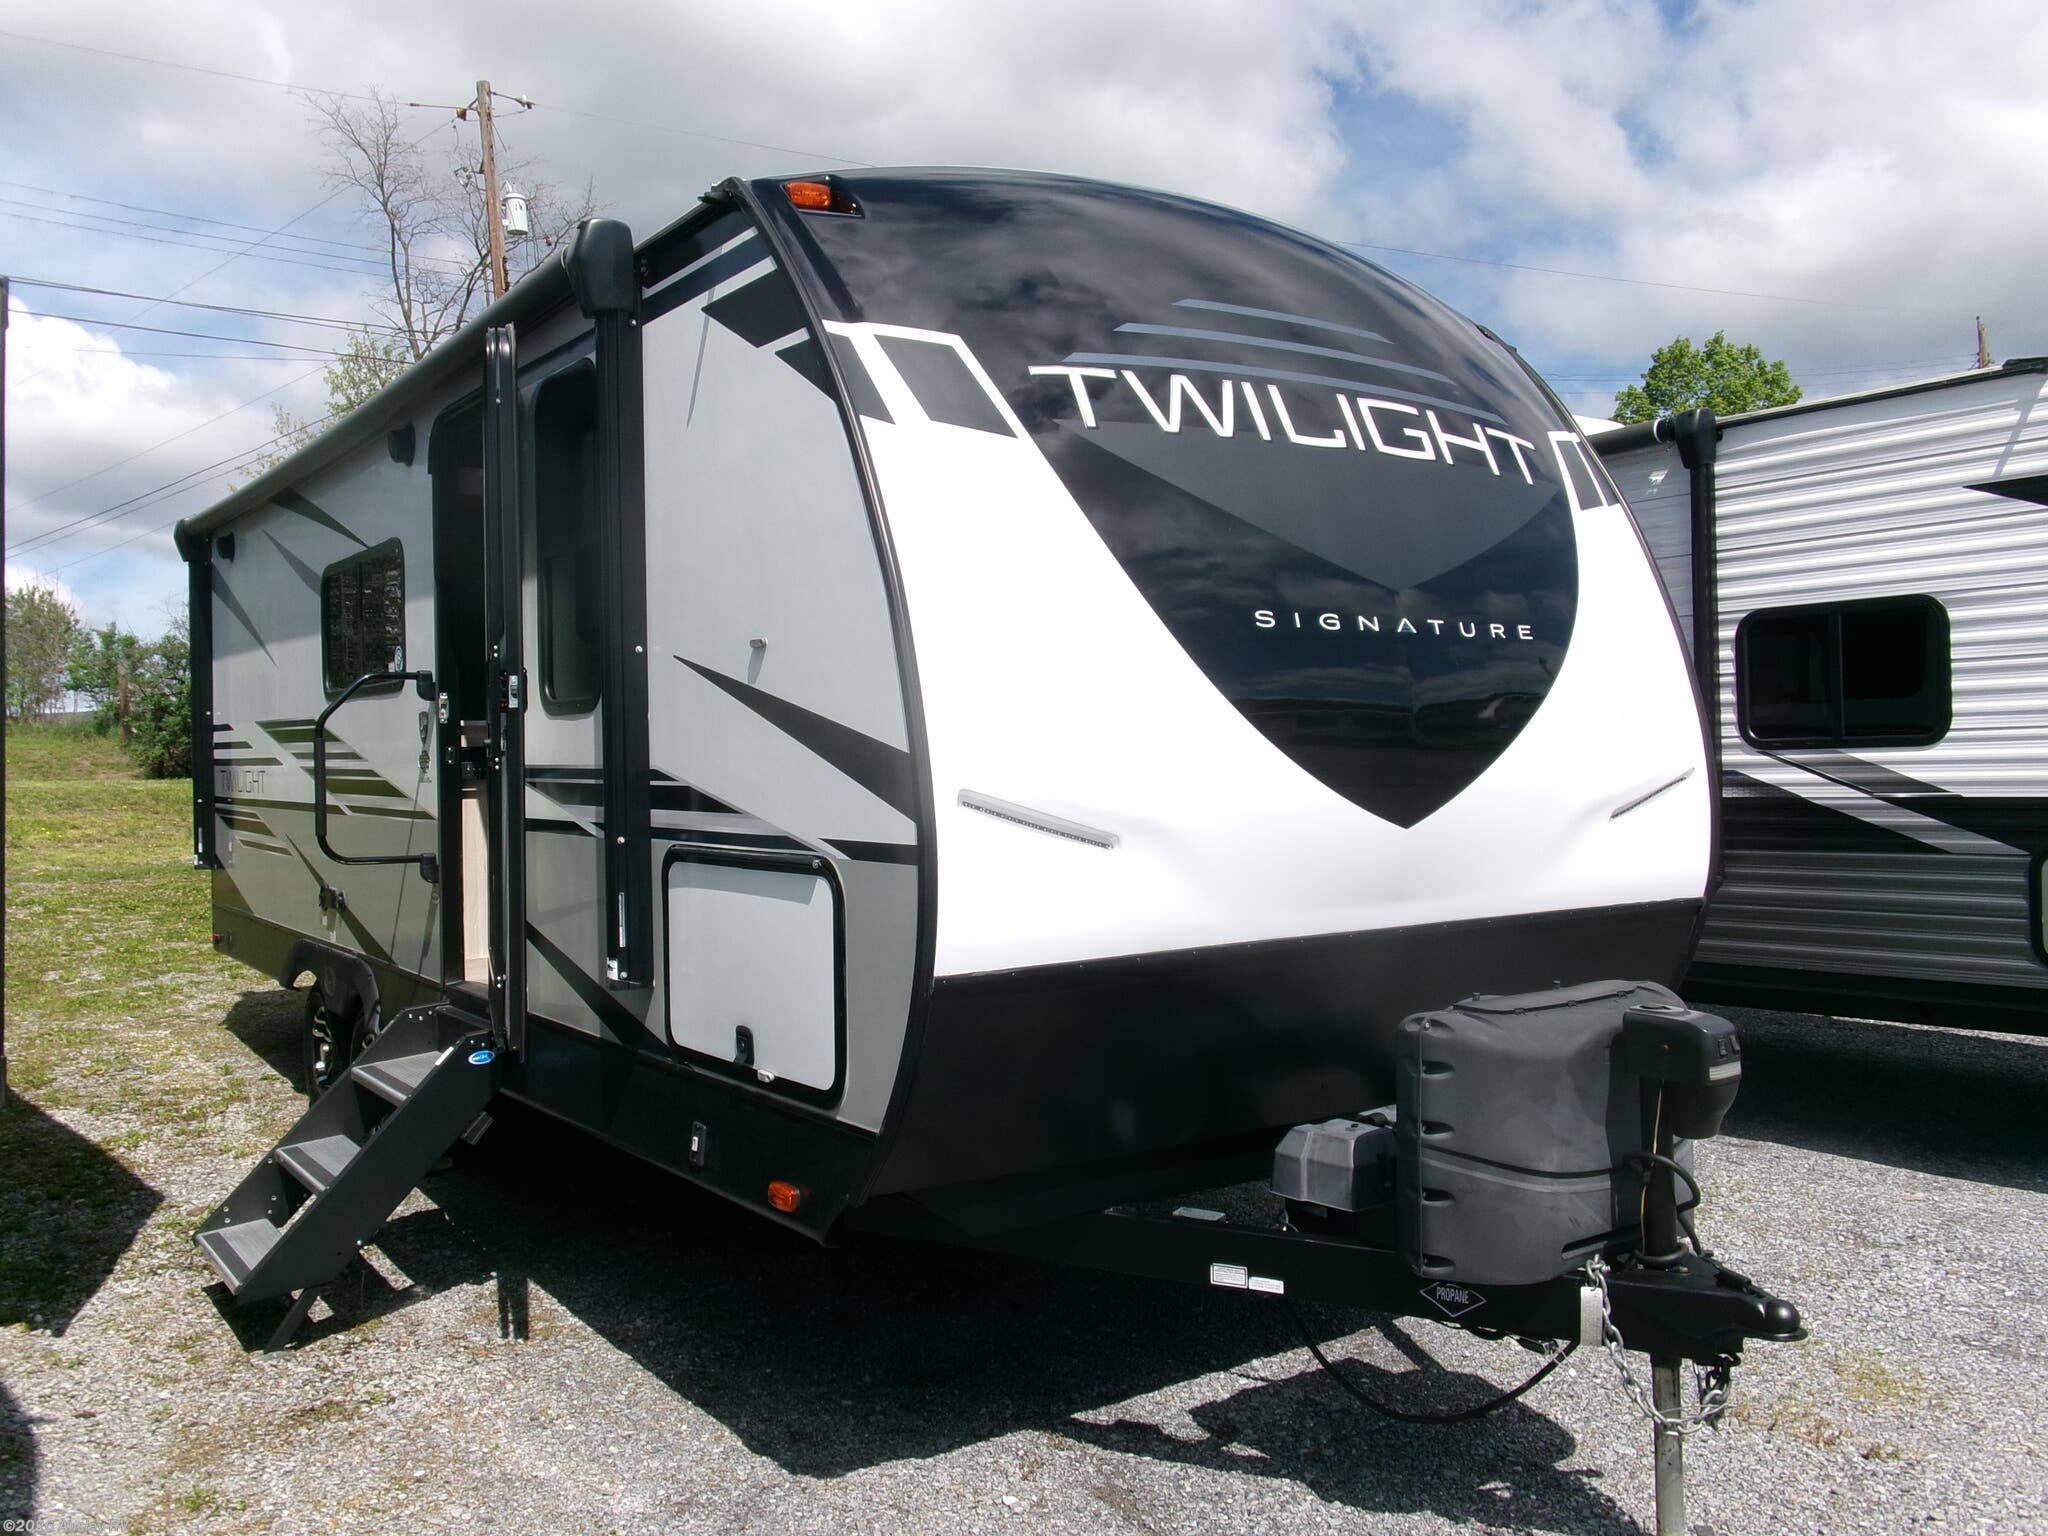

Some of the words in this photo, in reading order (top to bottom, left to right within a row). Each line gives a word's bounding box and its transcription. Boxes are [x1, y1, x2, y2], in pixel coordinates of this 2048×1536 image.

[1028, 365, 1535, 485] TWILIGHT
[1254, 609, 1534, 640] SIGNATURE
[220, 770, 266, 793] TWILIGHT
[1436, 1286, 1469, 1304] PROPANE
